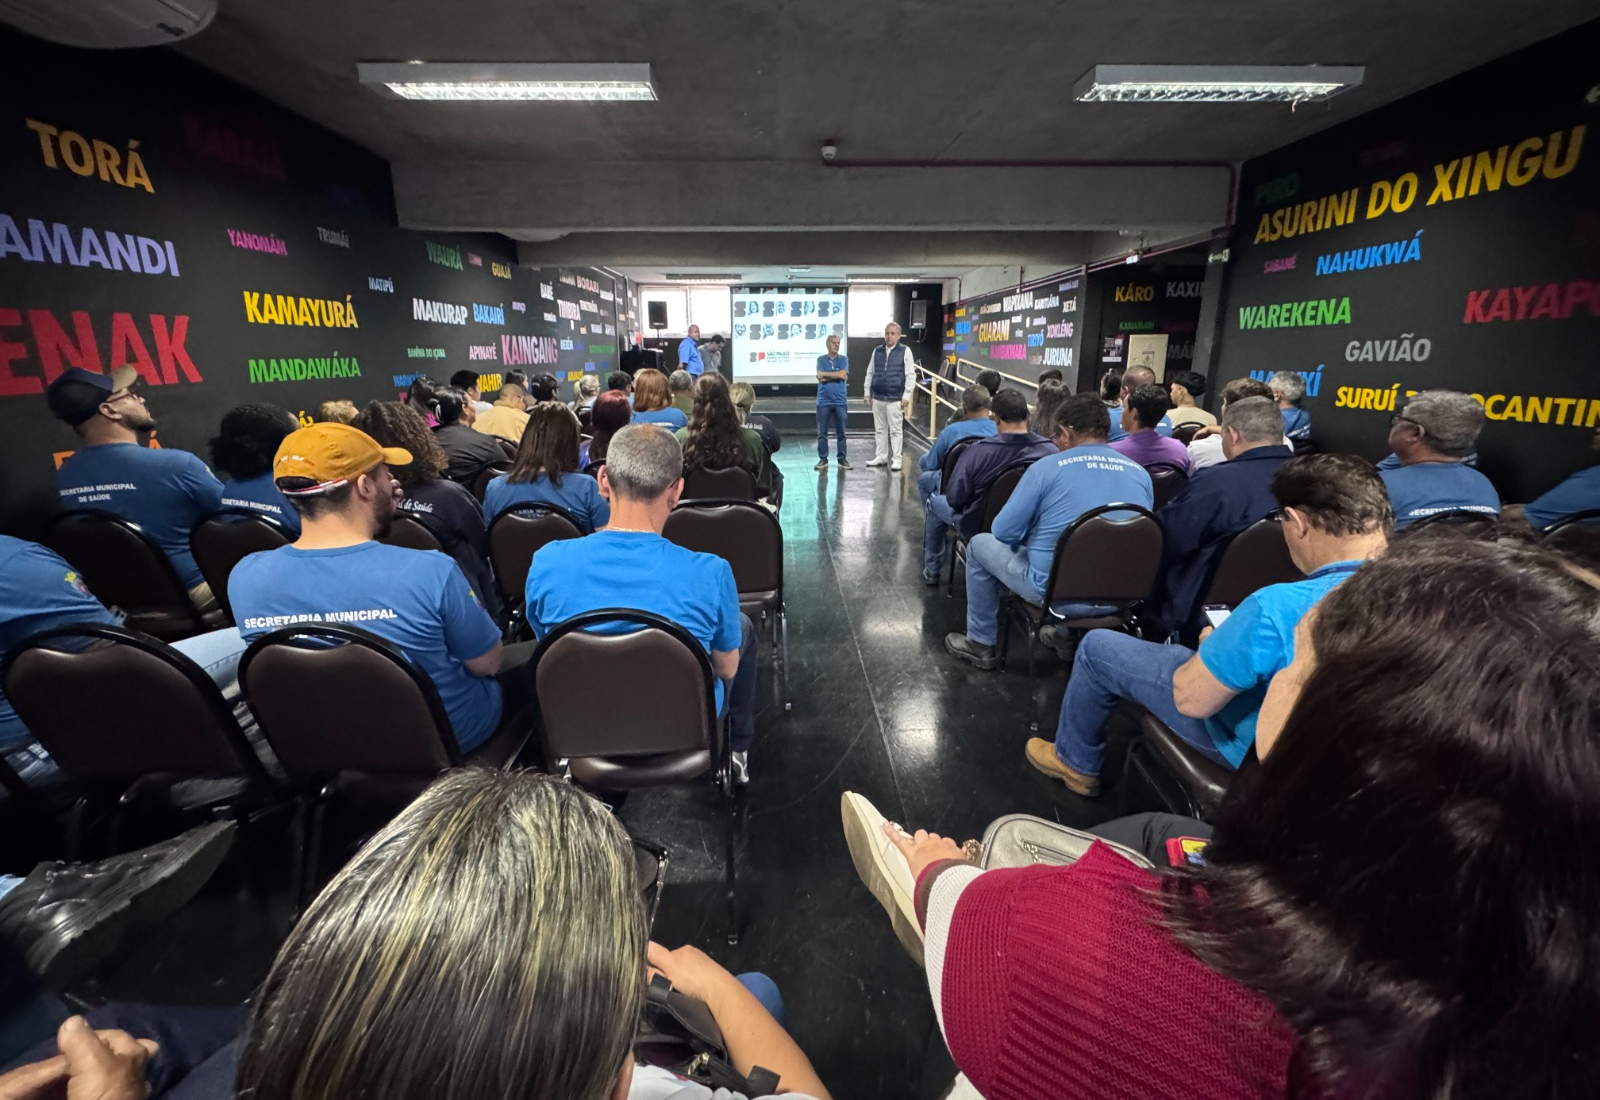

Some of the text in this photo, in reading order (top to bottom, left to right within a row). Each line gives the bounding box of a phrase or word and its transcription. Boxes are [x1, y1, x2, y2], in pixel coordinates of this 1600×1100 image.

[26, 117, 155, 193] TORÁ
[1254, 187, 1359, 244] ASURINI
[1366, 172, 1418, 219] DO
[1426, 124, 1587, 206] XINGU
[1315, 229, 1425, 276] NAHUKWÁ
[491, 261, 513, 280] GUAJÁ
[1114, 282, 1155, 302] KÁRO
[1166, 281, 1201, 298] KAXI
[243, 291, 359, 329] KAMAYURÁ
[412, 298, 468, 325] MAKURAP
[472, 302, 505, 325] BAKAIRÍ
[1062, 296, 1077, 313] XETÁ
[1239, 297, 1352, 330] WAREKENA
[979, 319, 1010, 343] GUARANI
[0, 308, 204, 396] ENAK
[469, 343, 498, 360] APINAYÉ
[501, 335, 559, 365] KAINGANG
[1042, 347, 1073, 367] JURUNA
[1344, 333, 1431, 362] GAVIÃO
[249, 351, 361, 383] MANDAWÁKA
[1335, 383, 1600, 428] SURUÍ CANTI
[1058, 455, 1107, 467] SECRETARIA
[60, 483, 136, 496] SECRETARIA MUNICIPAL
[412, 500, 433, 513] Saúde
[1409, 507, 1457, 516] SECRET
[244, 608, 398, 628] SECRETARIA MUNICIPAL
